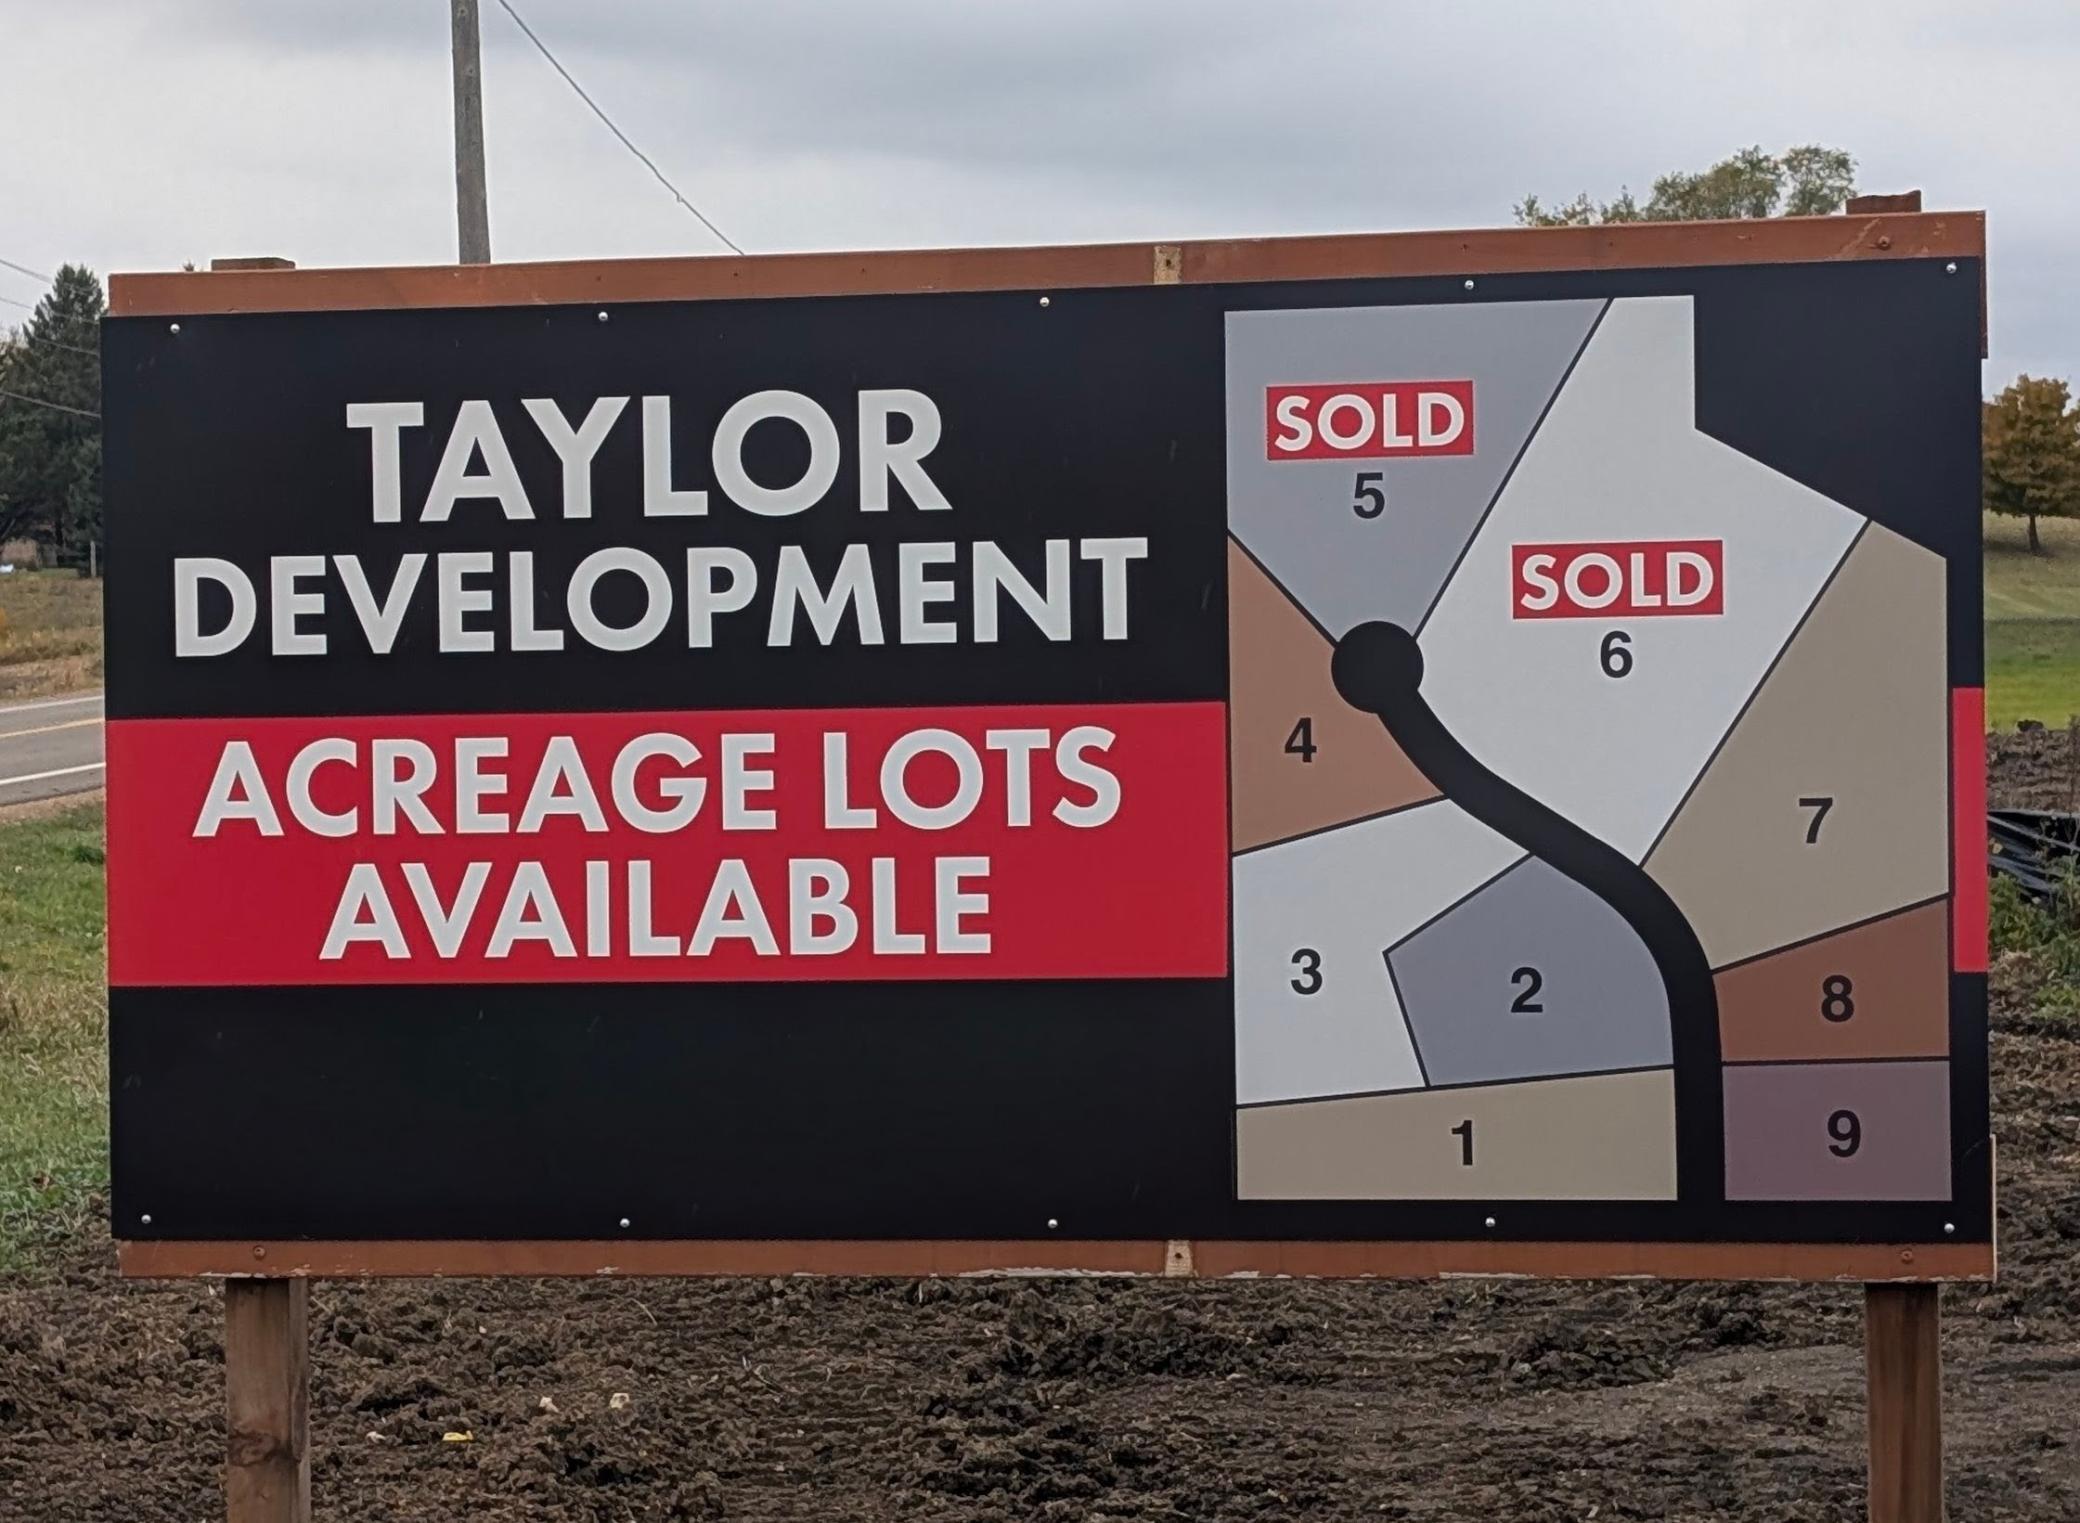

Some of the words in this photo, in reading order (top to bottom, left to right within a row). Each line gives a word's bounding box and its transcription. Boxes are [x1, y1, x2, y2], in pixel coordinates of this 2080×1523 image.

[1273, 391, 1465, 452] SOLD
[347, 389, 952, 522] TAYLOR
[1353, 472, 1385, 519] 5
[175, 537, 1148, 657] DEVELOPMENT
[1520, 552, 1714, 611] SOLD
[1600, 630, 1633, 678] 6
[1284, 717, 1318, 763] 4
[193, 733, 777, 838] ACREAGE
[824, 726, 1121, 830] LOTS
[1799, 797, 1834, 844] 7
[320, 857, 991, 960] AVAILABLE
[1291, 948, 1323, 995] 3
[1510, 966, 1543, 1013] 2
[1821, 974, 1855, 1023] 8
[1450, 1119, 1474, 1166] 1
[1827, 1109, 1862, 1158] 9
